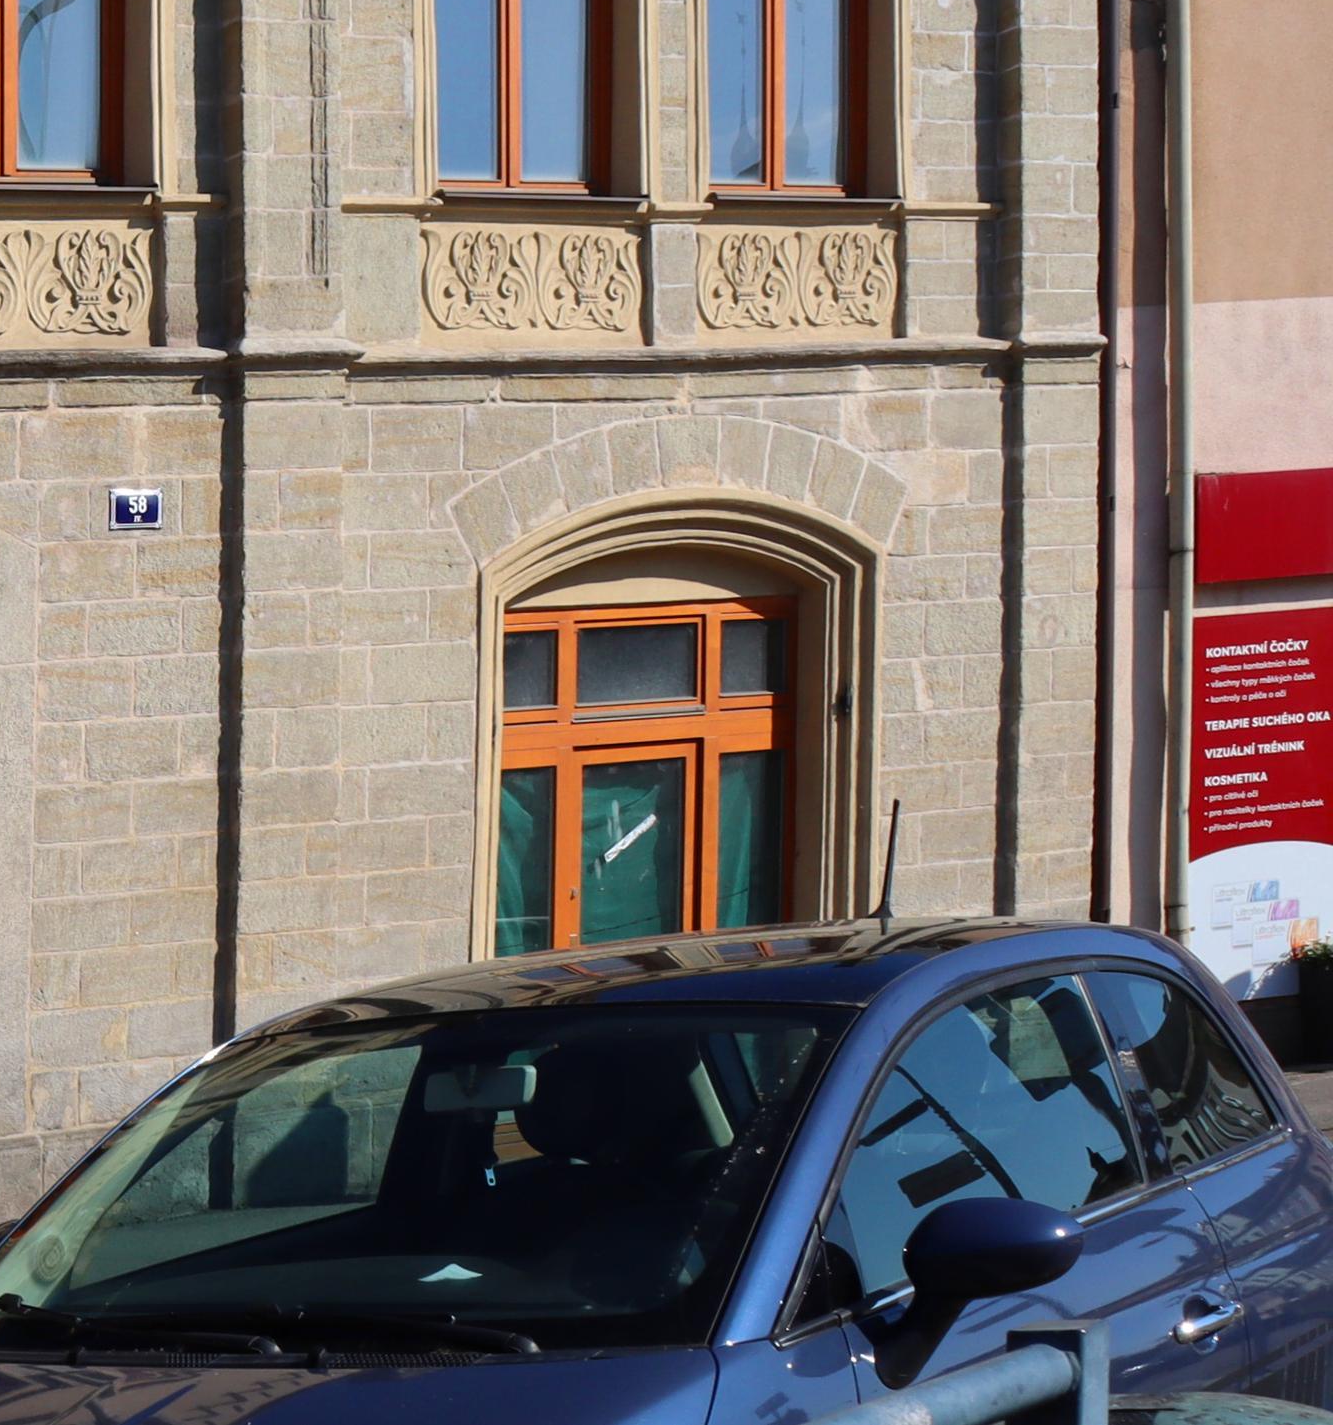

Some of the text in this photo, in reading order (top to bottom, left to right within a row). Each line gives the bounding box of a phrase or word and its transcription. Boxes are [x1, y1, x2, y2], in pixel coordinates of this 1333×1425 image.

[129, 496, 147, 514] 58
[1205, 638, 1309, 658] KONTAKTNÍ ČOČKY
[1205, 711, 1331, 732] TERAPIE SUCHÉHO OKA
[1204, 740, 1305, 759] VIZUÁLNÍ TRÉNINK
[1204, 771, 1268, 787] KOSMETIKA
